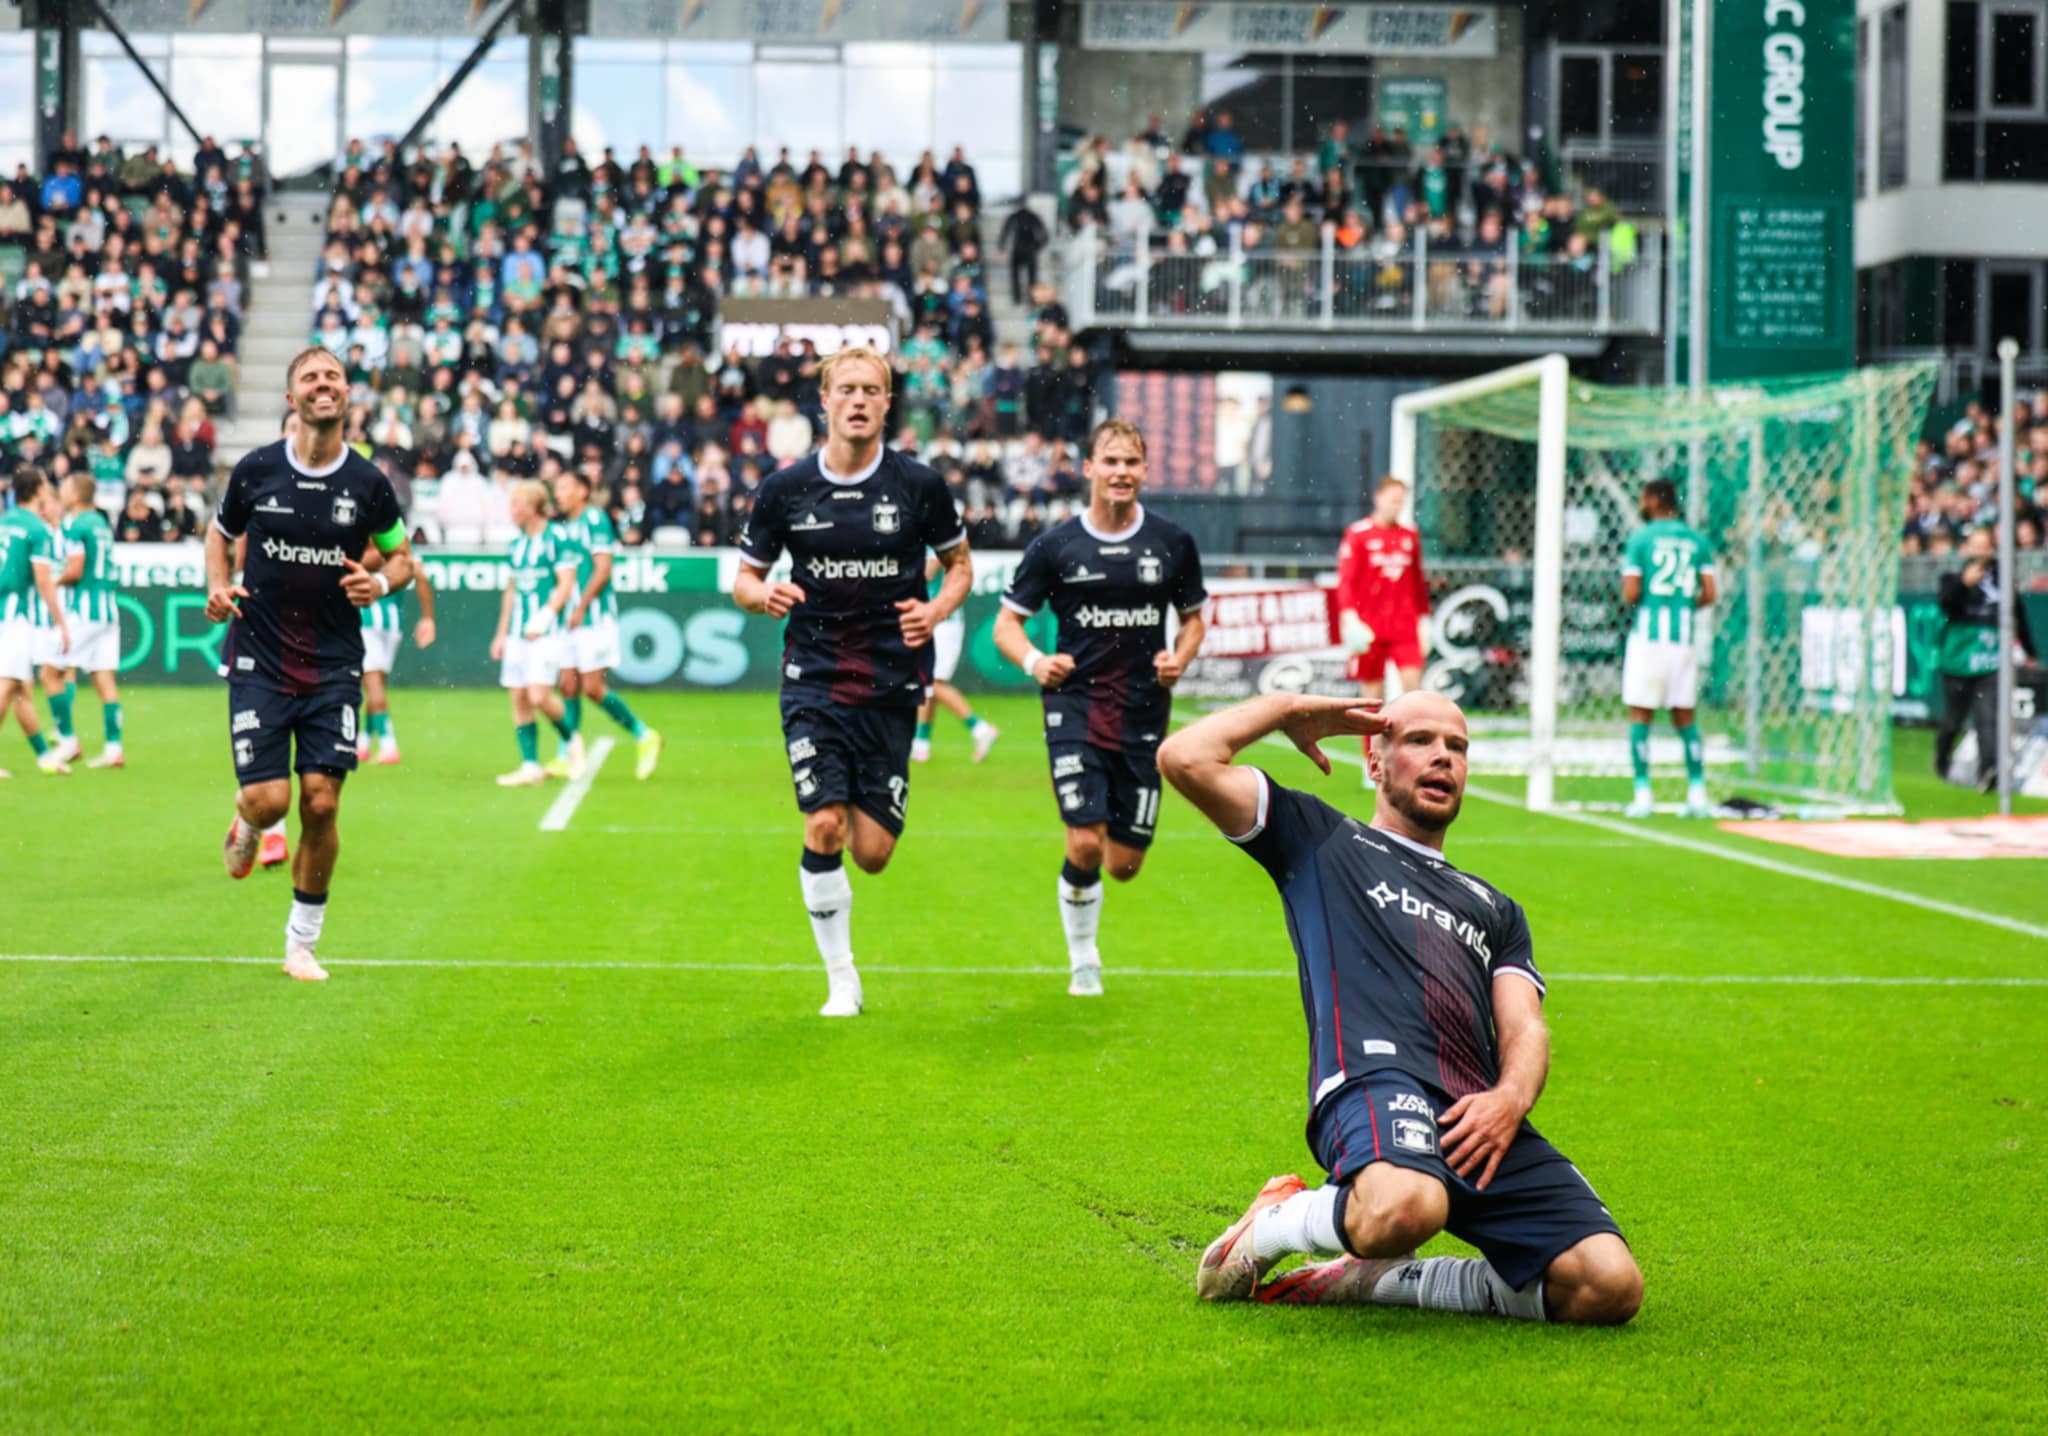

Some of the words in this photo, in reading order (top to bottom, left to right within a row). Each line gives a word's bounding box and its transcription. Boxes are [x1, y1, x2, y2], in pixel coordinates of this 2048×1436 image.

[1763, 32, 1805, 170] GROUP
[824, 556, 899, 579] bravida
[1650, 549, 1697, 597] 24
[1092, 603, 1160, 628] bravida
[341, 703, 356, 741] 9
